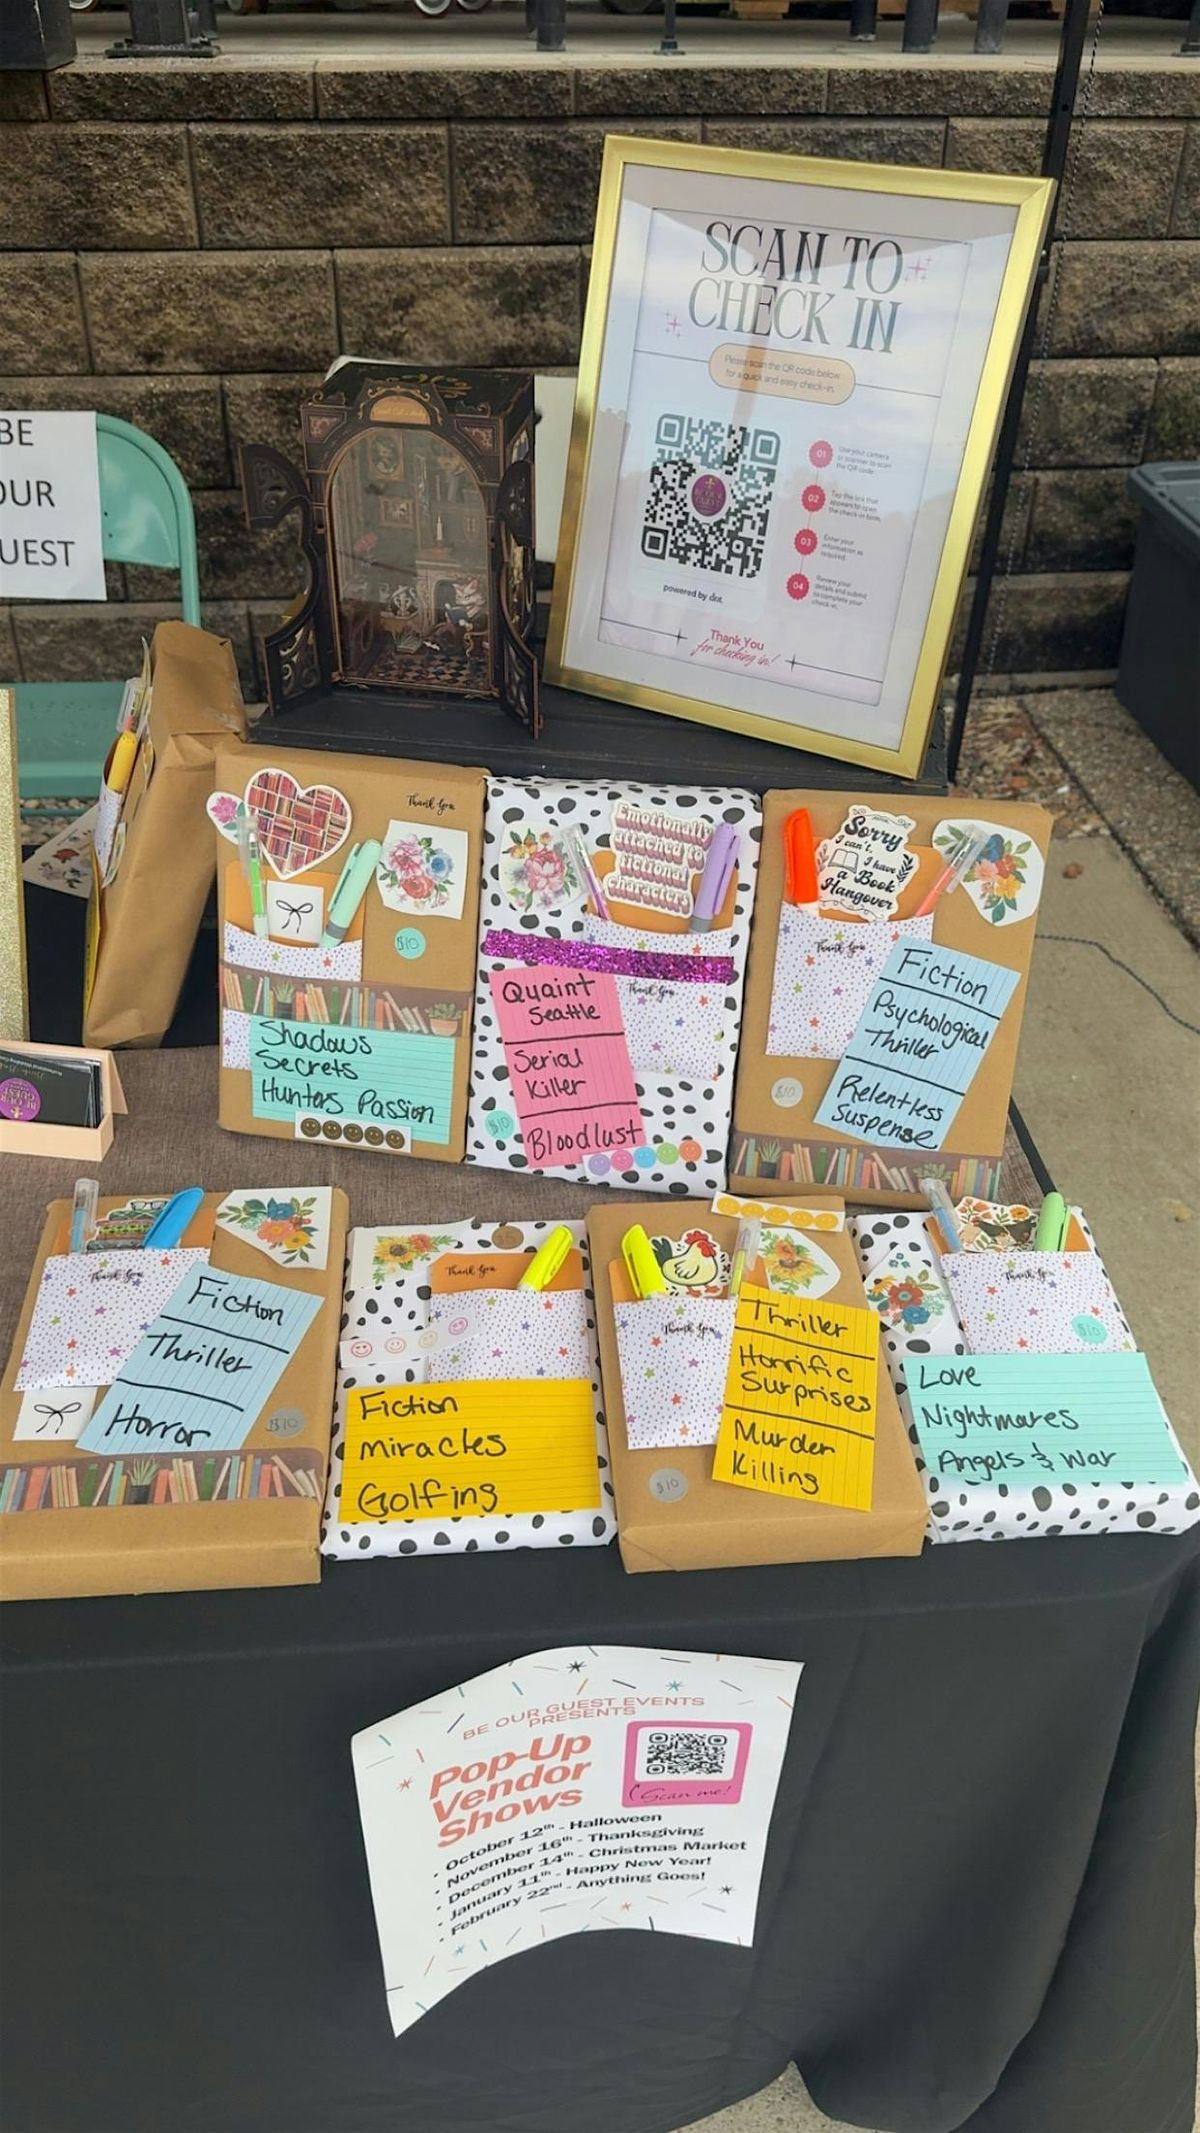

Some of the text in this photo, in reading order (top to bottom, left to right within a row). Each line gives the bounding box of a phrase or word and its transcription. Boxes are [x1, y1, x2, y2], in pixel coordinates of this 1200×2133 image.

[701, 221, 904, 294] SCAN TO
[688, 277, 902, 353] CHECK IN
[725, 354, 840, 379] Please scan the QR code below
[743, 371, 762, 381] quick
[764, 375, 779, 384] and
[780, 378, 799, 389] easy
[0, 419, 34, 446] BE
[816, 449, 826, 458] 01
[808, 494, 819, 503] 02
[801, 538, 811, 546] 03
[663, 585, 707, 601] powered by
[793, 582, 803, 590] 04
[690, 638, 714, 656] for
[714, 643, 756, 667] checking
[711, 628, 764, 650] Thank You
[406, 792, 435, 810] Thank
[616, 804, 713, 848] Emotionally
[835, 834, 845, 844] I
[845, 815, 903, 852] Sorry
[614, 831, 704, 868] attached to
[873, 859, 896, 874] have
[620, 854, 688, 888] fictional
[837, 869, 895, 893] a Book
[608, 875, 690, 912] characters
[821, 877, 893, 910] Hangover
[396, 936, 419, 951] $10
[502, 973, 596, 1004] Quaint
[897, 948, 988, 1005] Fiction
[529, 1003, 601, 1026] Seattle
[873, 990, 989, 1050] Psychological
[259, 1020, 372, 1055] Shadows
[865, 1028, 939, 1060] Thriller
[255, 1049, 359, 1080] Secrets
[514, 1049, 584, 1074] Serial
[525, 1078, 587, 1099] Killer
[837, 1075, 944, 1122] Relentless
[357, 1089, 434, 1124] Passion
[832, 1103, 939, 1149] Suspense
[445, 1264, 475, 1276] Thank
[188, 1275, 283, 1325] Fiction
[741, 1299, 848, 1337] Thriller
[147, 1333, 252, 1373] Thriller
[740, 1346, 853, 1383] Horrific
[741, 1371, 871, 1412] Surprises
[919, 1365, 982, 1389] Love
[360, 1391, 458, 1419] Fiction
[921, 1403, 1079, 1439] Nightmares
[105, 1403, 211, 1447] Horror
[735, 1420, 835, 1456] Murder
[733, 1450, 820, 1495] Killing
[938, 1442, 1117, 1481] Angels & War
[358, 1479, 498, 1517] Golfing
[463, 1697, 705, 1741] BE OUR GUEST EVENTS
[529, 1706, 636, 1728] PRESENTS
[429, 1733, 591, 1800] Pop-Up
[432, 1761, 592, 1824] Vendor
[640, 1785, 731, 1804] Scan me!
[437, 1788, 583, 1848] Shows
[446, 1813, 662, 1871] October 12th Halloween
[447, 1826, 705, 1889] November 16th Thanksgiving
[449, 1840, 747, 1904] December 14th Christmas Market
[450, 1856, 711, 1921] January 11th Happy New Year!
[451, 1895, 522, 1936] February
[577, 1872, 652, 1889] Anything
[657, 1871, 706, 1881] Goes!
